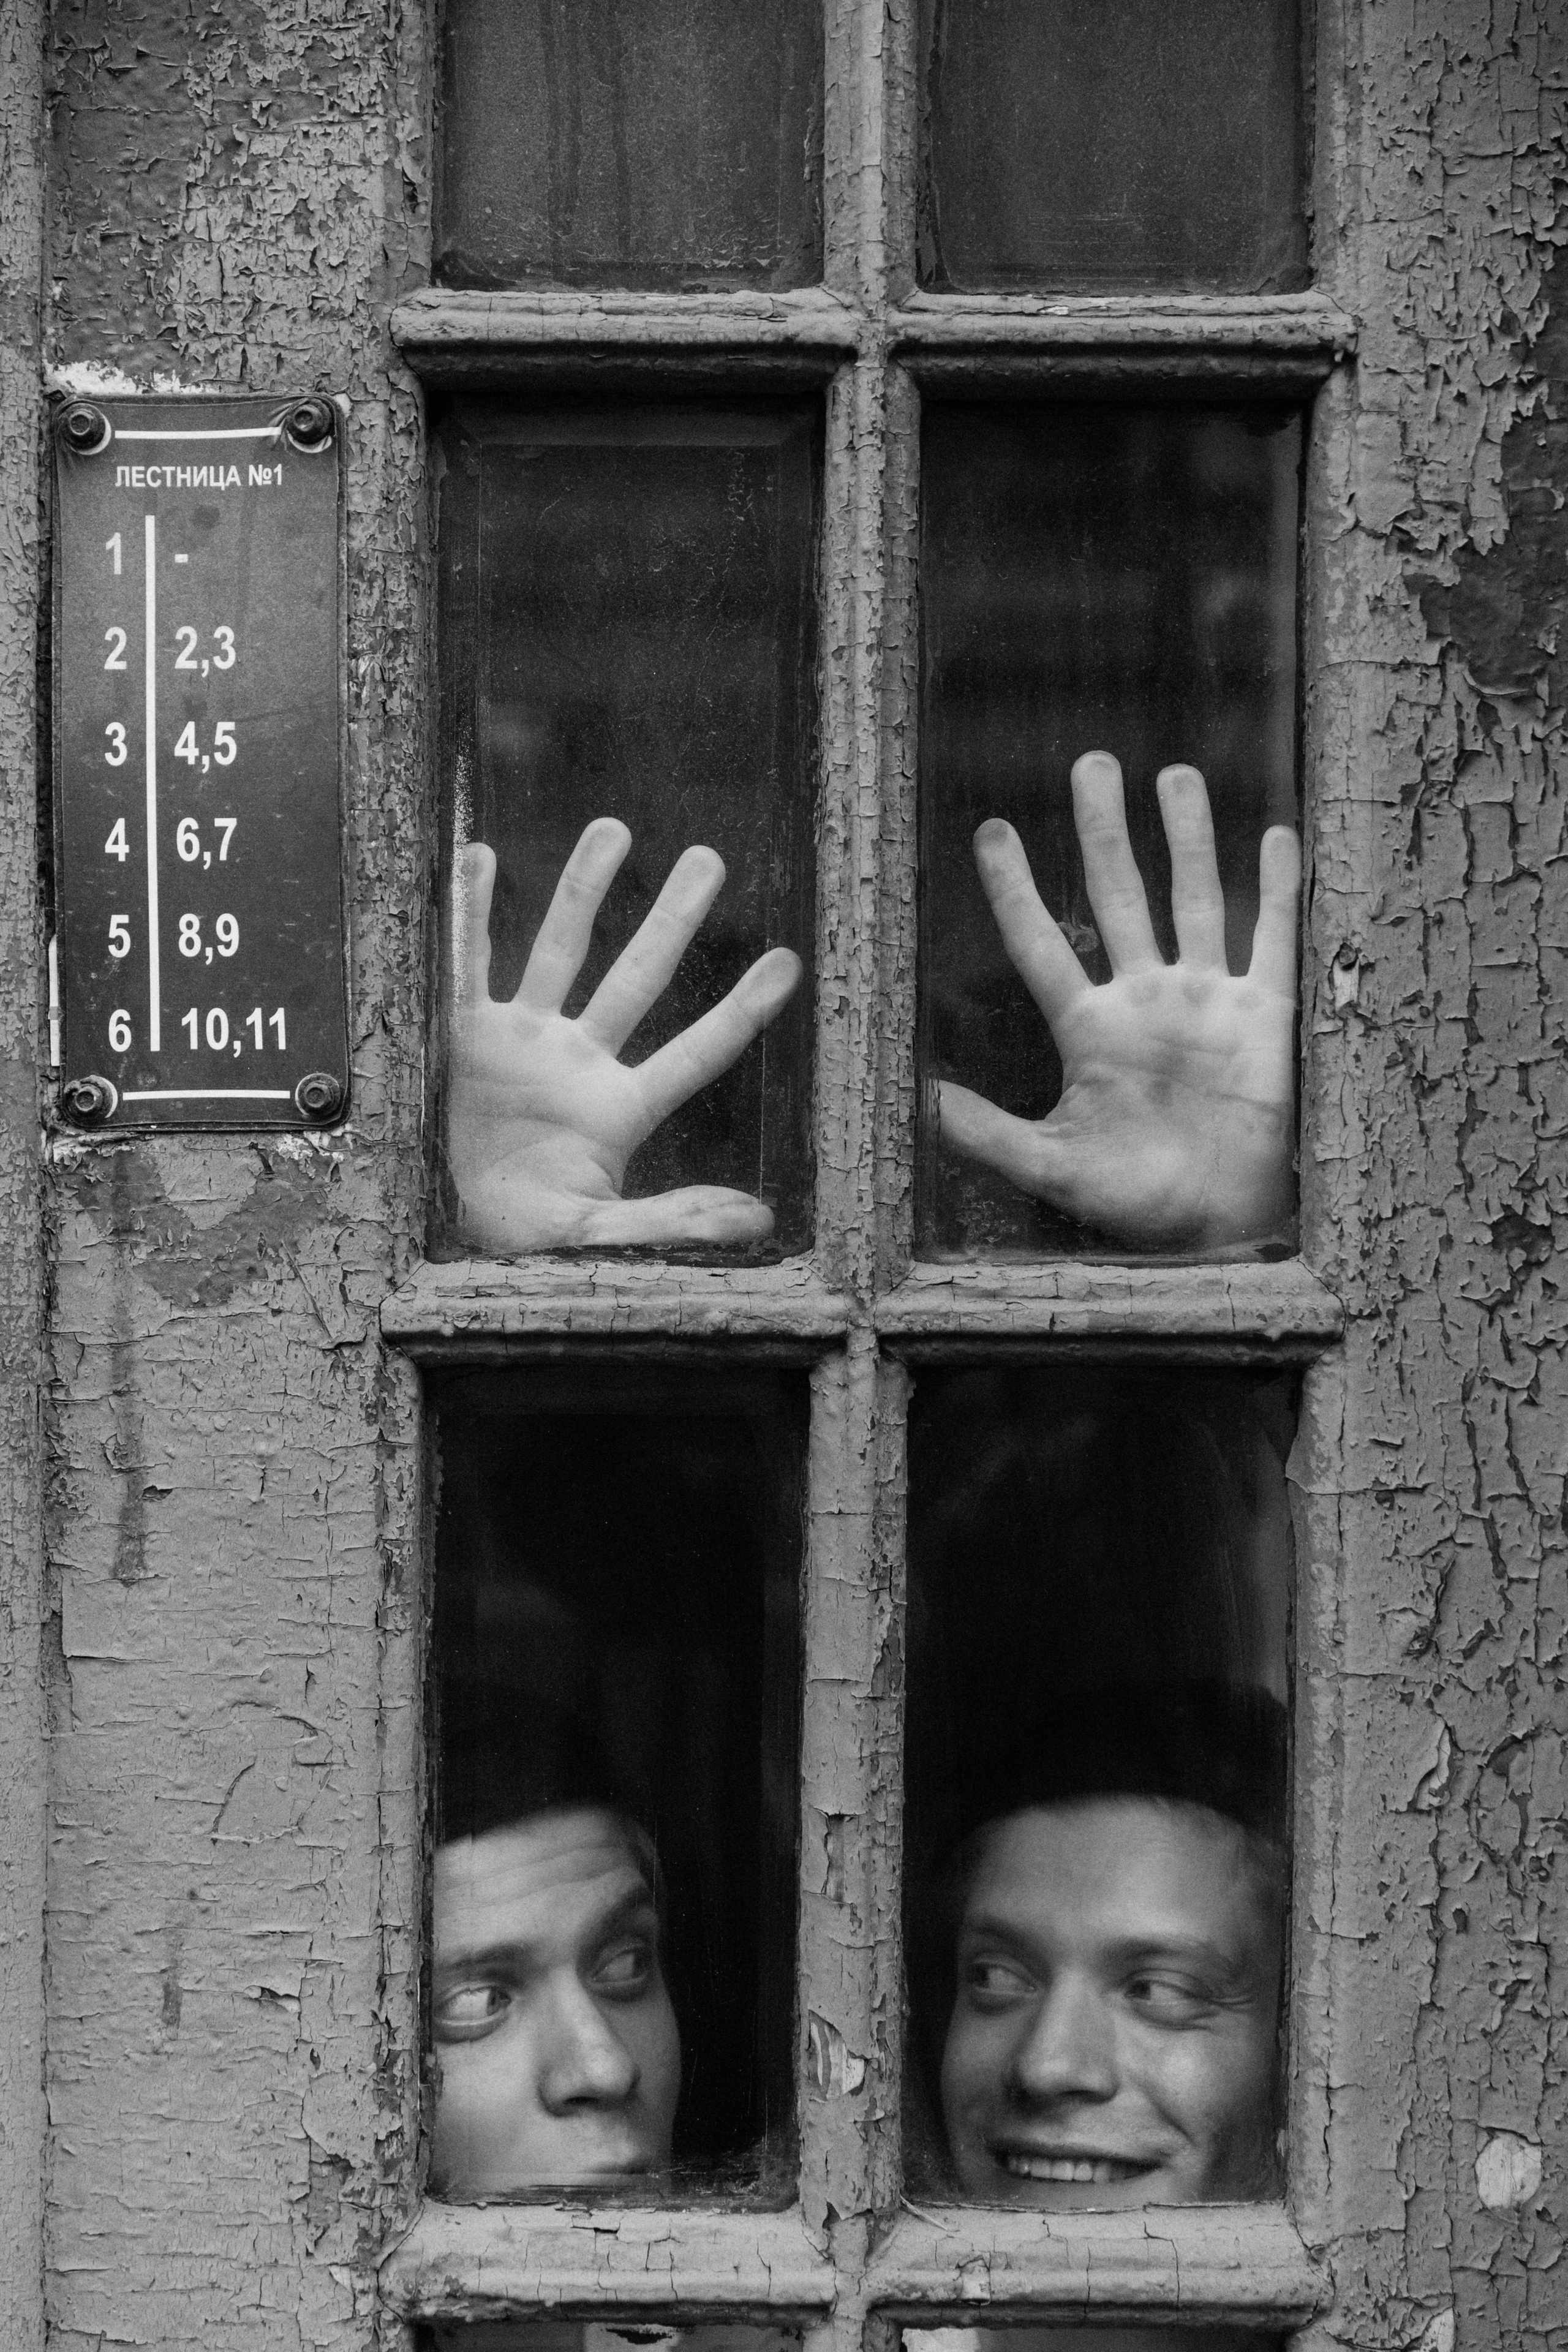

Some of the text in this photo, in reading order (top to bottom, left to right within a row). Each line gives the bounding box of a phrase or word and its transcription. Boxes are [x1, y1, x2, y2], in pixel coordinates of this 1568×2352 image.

[115, 464, 283, 491] ЛЕСТНИЦА №1
[105, 532, 123, 576] 1
[104, 625, 236, 679] 2 2,3
[104, 721, 238, 774] 3 4,5
[105, 817, 238, 870] 4 6,7
[108, 913, 240, 966] 5 8,9
[108, 1007, 287, 1058] 6 10,11
